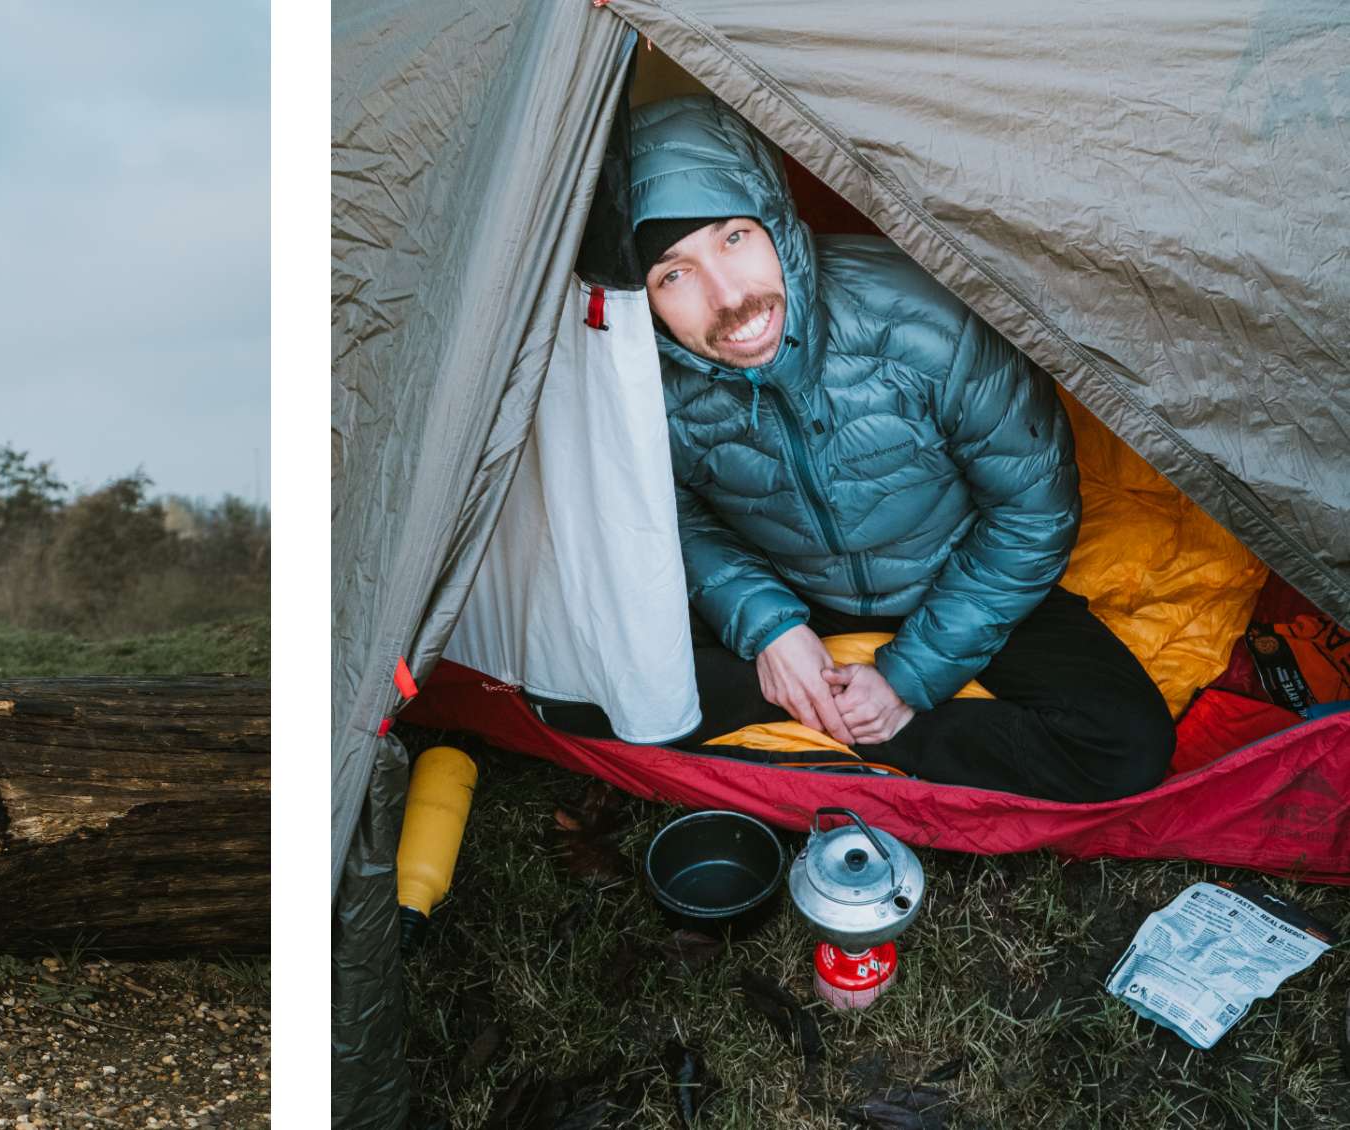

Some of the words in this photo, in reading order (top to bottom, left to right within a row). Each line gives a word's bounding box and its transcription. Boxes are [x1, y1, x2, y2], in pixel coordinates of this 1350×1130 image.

[1233, 896, 1255, 912] TASTE
[1259, 913, 1279, 927] REAL
[1278, 923, 1309, 940] ENERGY
